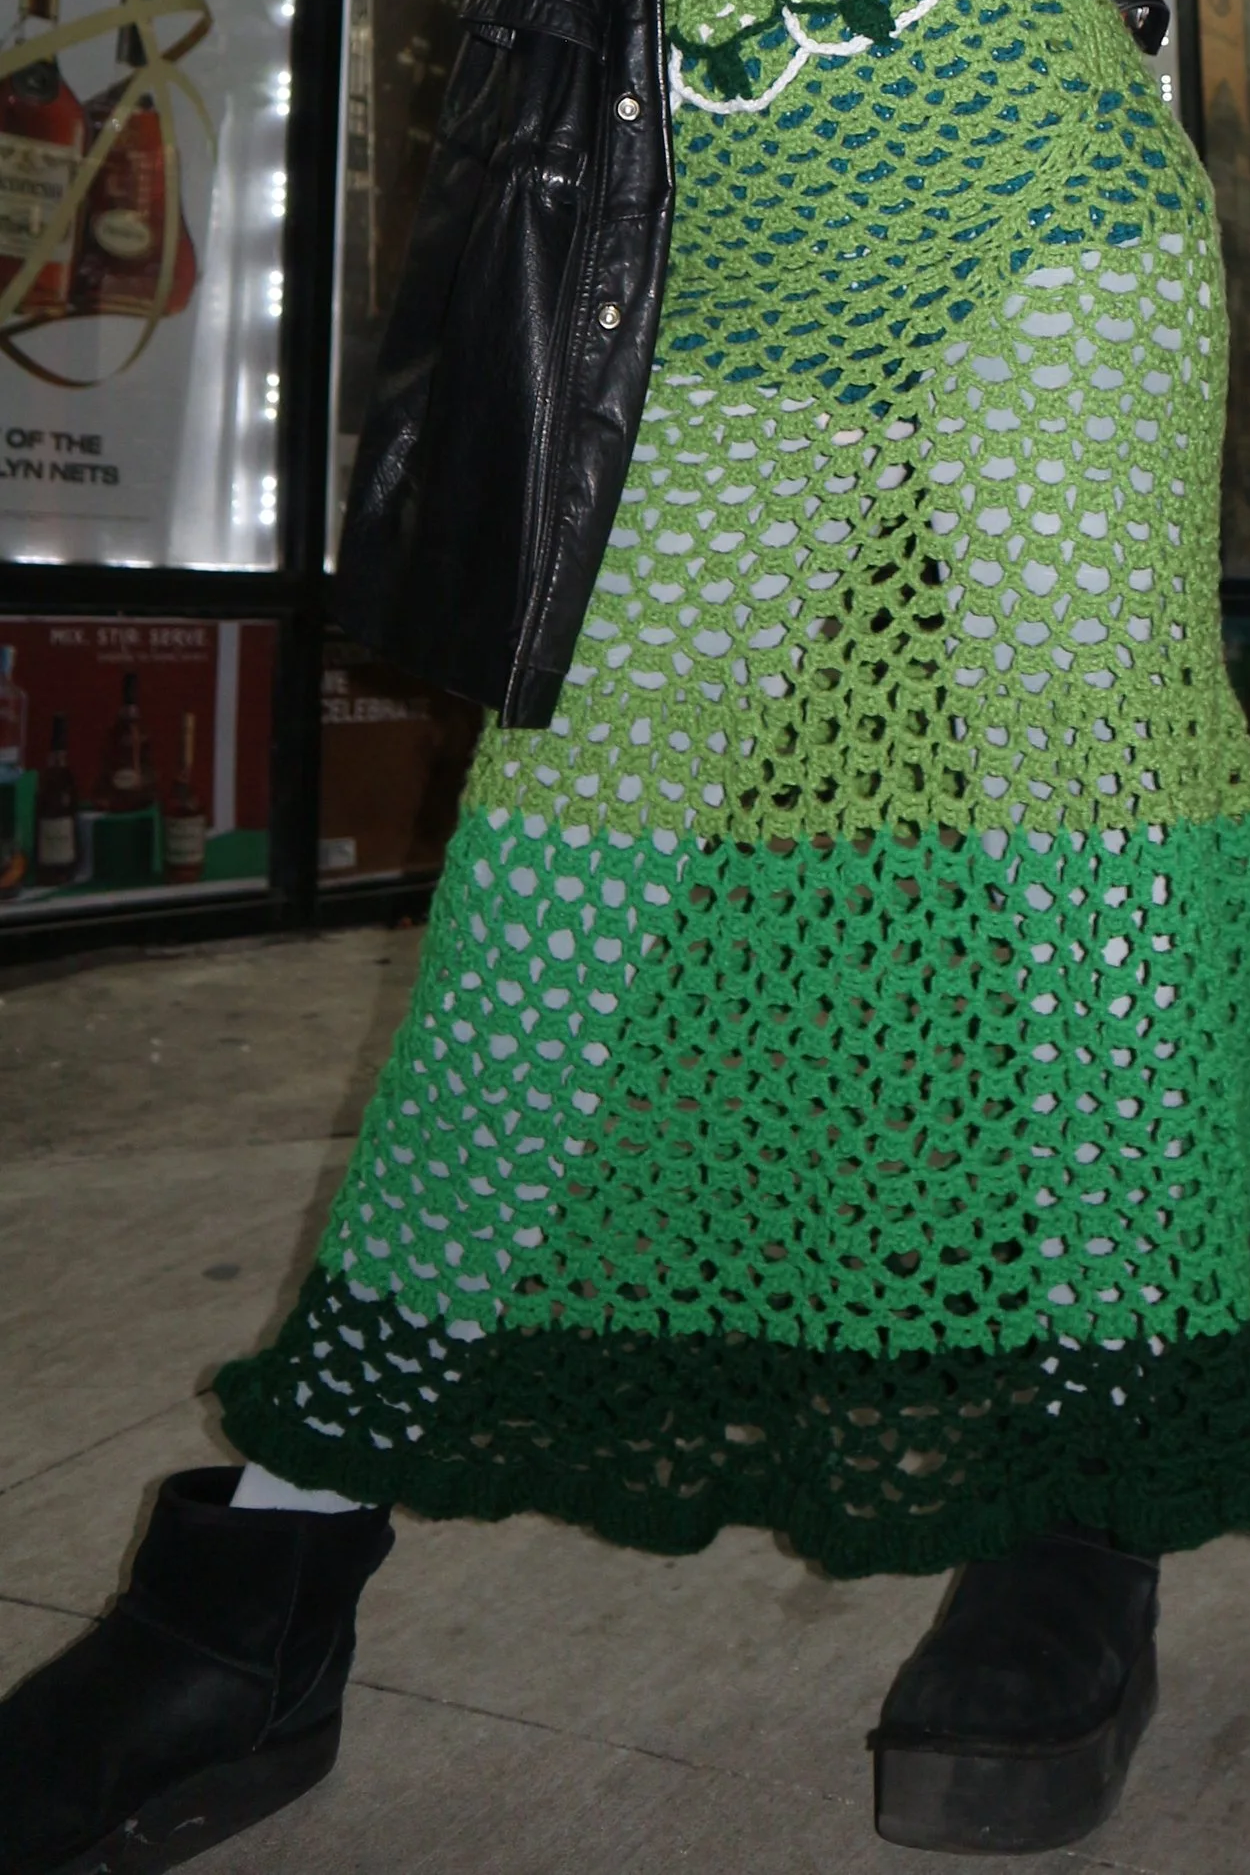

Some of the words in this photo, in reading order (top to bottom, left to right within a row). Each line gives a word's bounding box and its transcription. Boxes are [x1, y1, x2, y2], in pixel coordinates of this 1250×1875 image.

[5, 427, 44, 450] OF
[50, 431, 104, 456] THE
[49, 461, 120, 487] NETS
